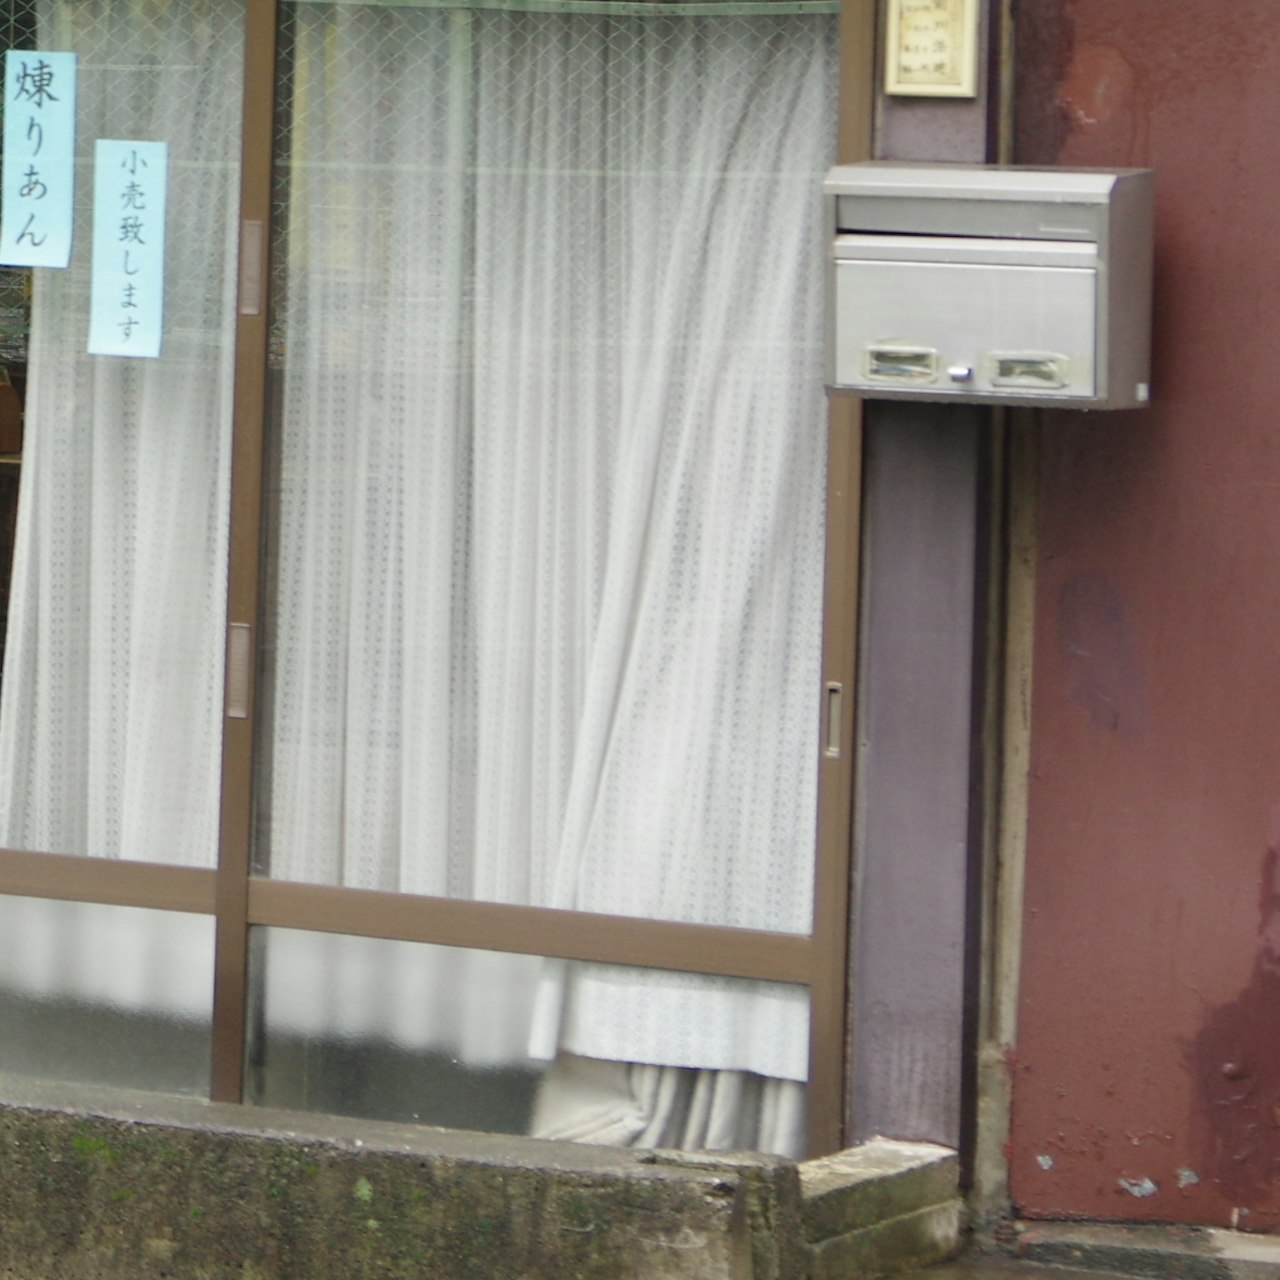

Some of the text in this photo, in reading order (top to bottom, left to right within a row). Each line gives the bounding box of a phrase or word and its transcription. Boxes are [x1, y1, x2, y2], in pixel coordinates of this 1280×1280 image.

[116, 149, 149, 344] 小売致します
